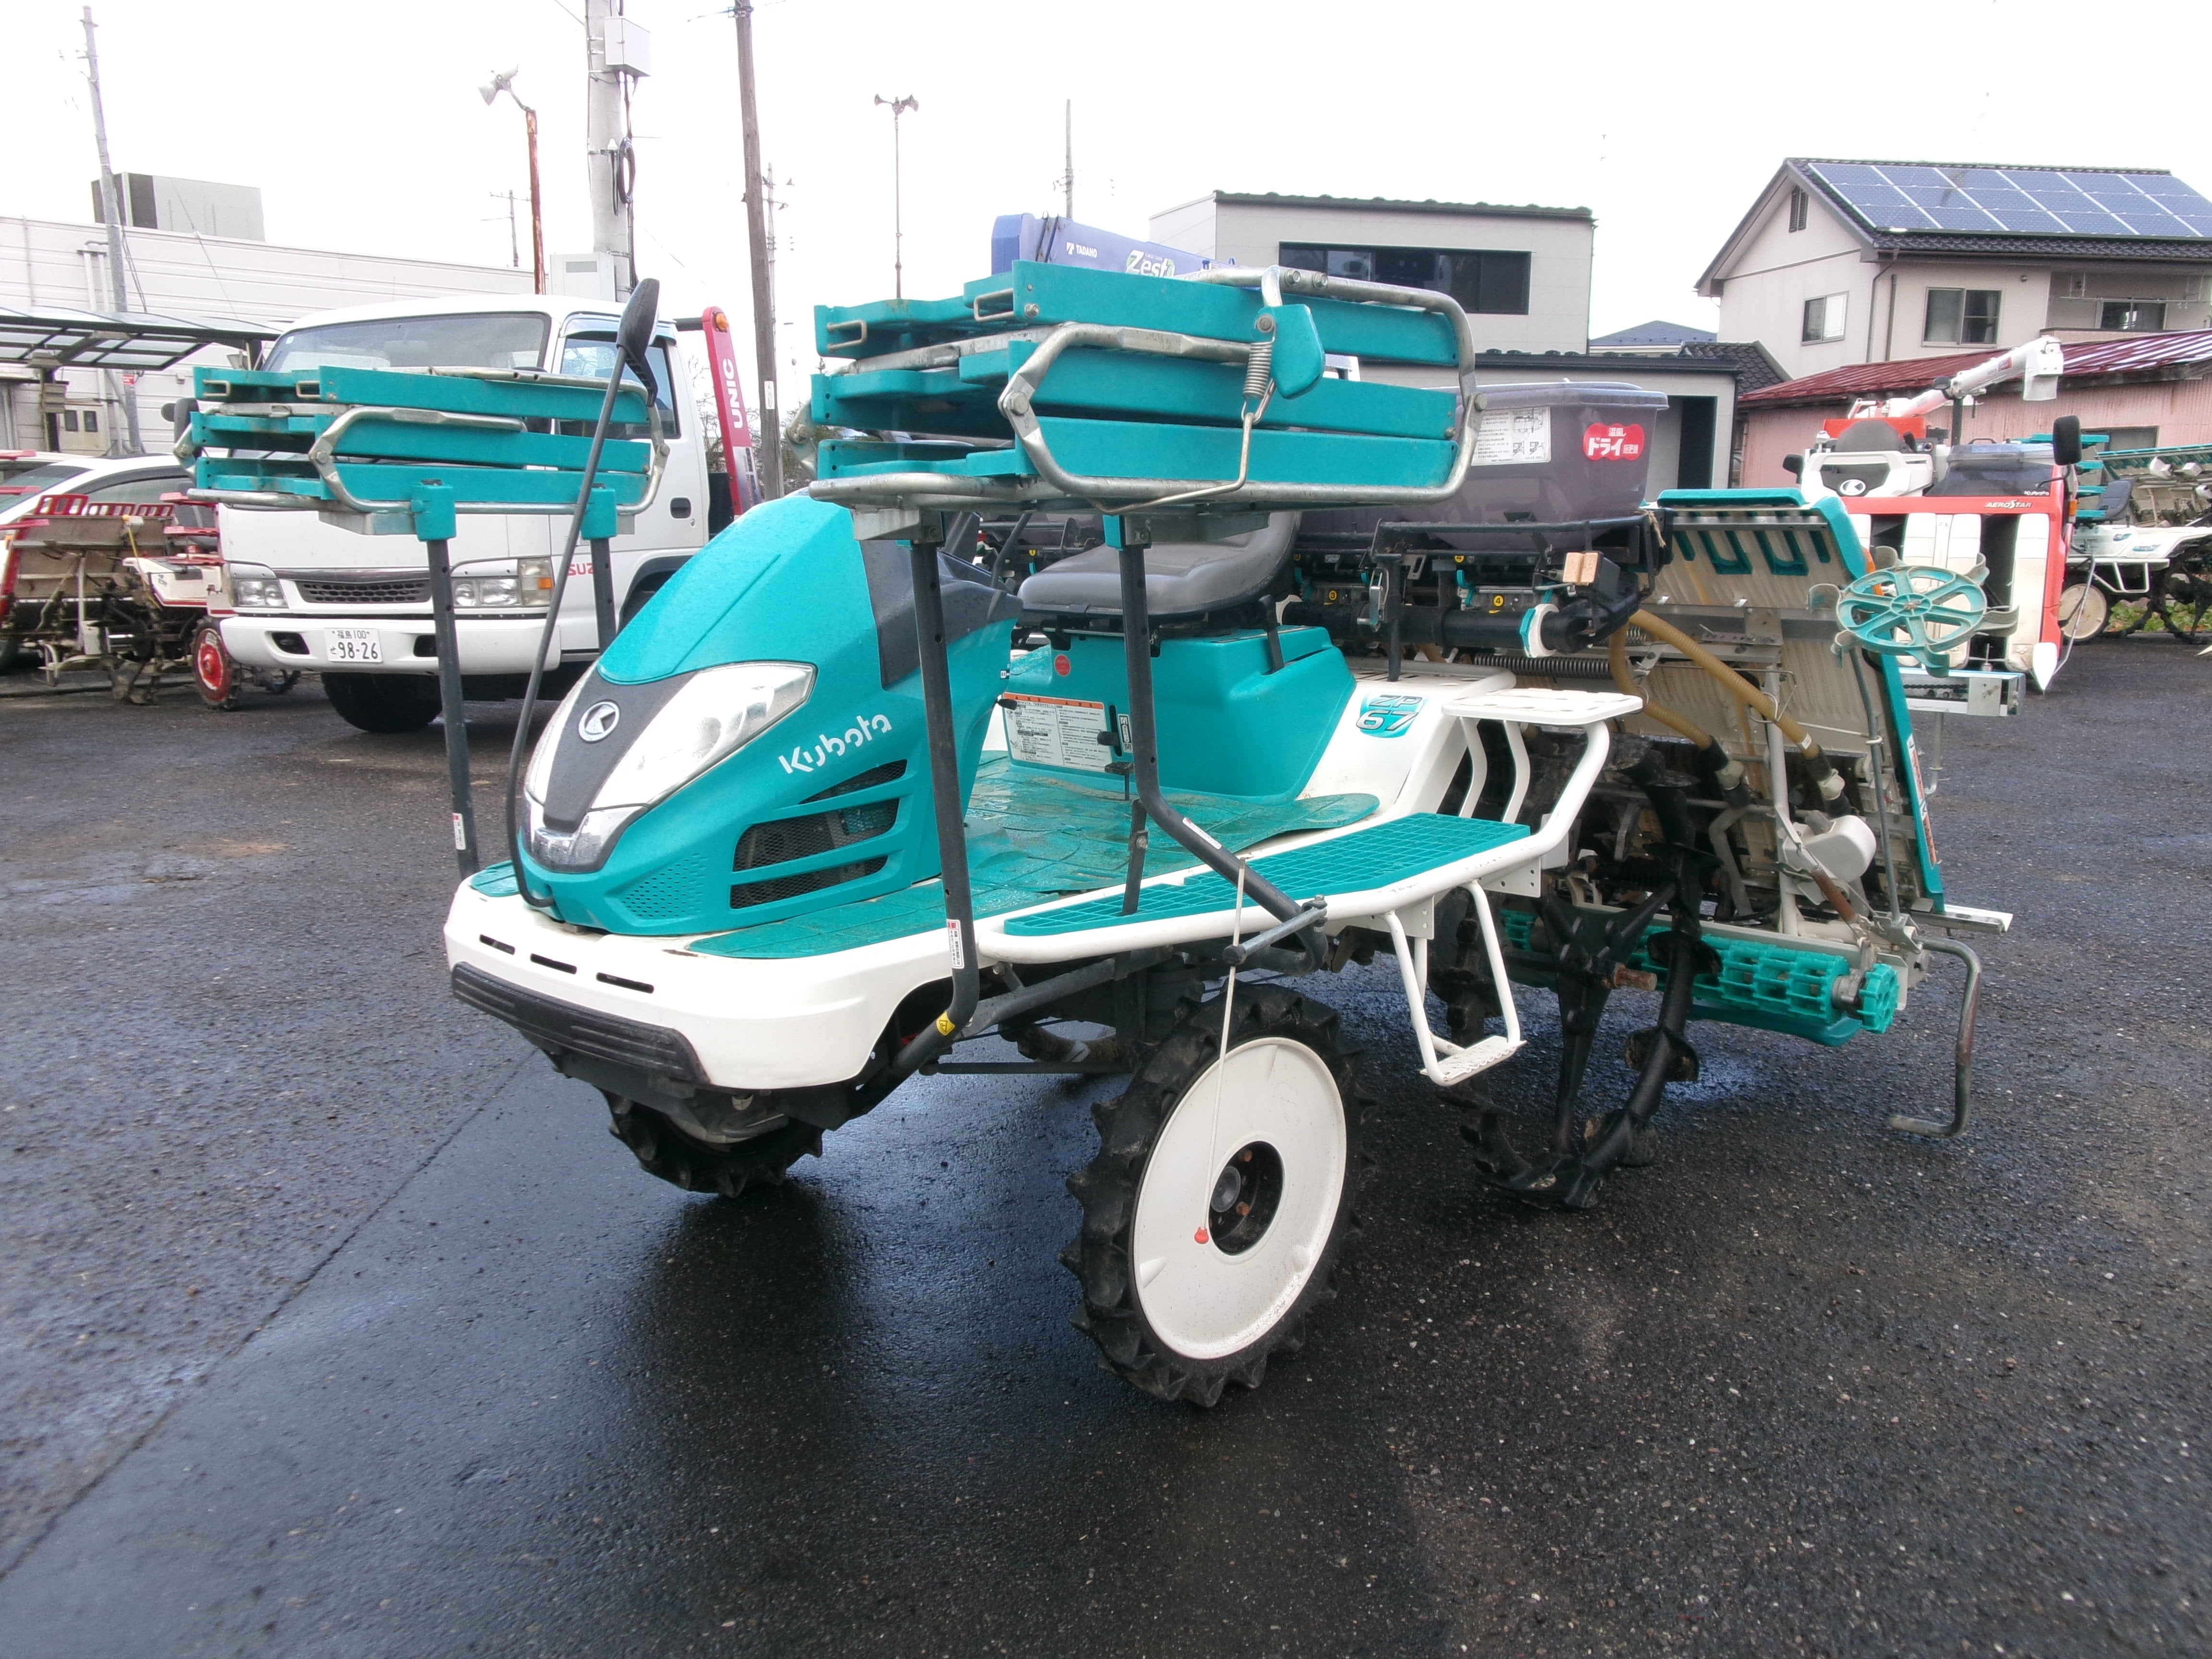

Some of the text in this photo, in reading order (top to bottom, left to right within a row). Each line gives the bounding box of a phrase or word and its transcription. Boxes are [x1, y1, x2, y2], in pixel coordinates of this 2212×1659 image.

[1076, 244, 1098, 258] TADANO
[722, 358, 743, 428] UNIC
[1985, 500, 2032, 509] AEROSTAR
[338, 642, 378, 660] 98-26
[1369, 695, 1423, 708] ZP
[1356, 709, 1419, 732] 67
[778, 714, 892, 774] Kubota
